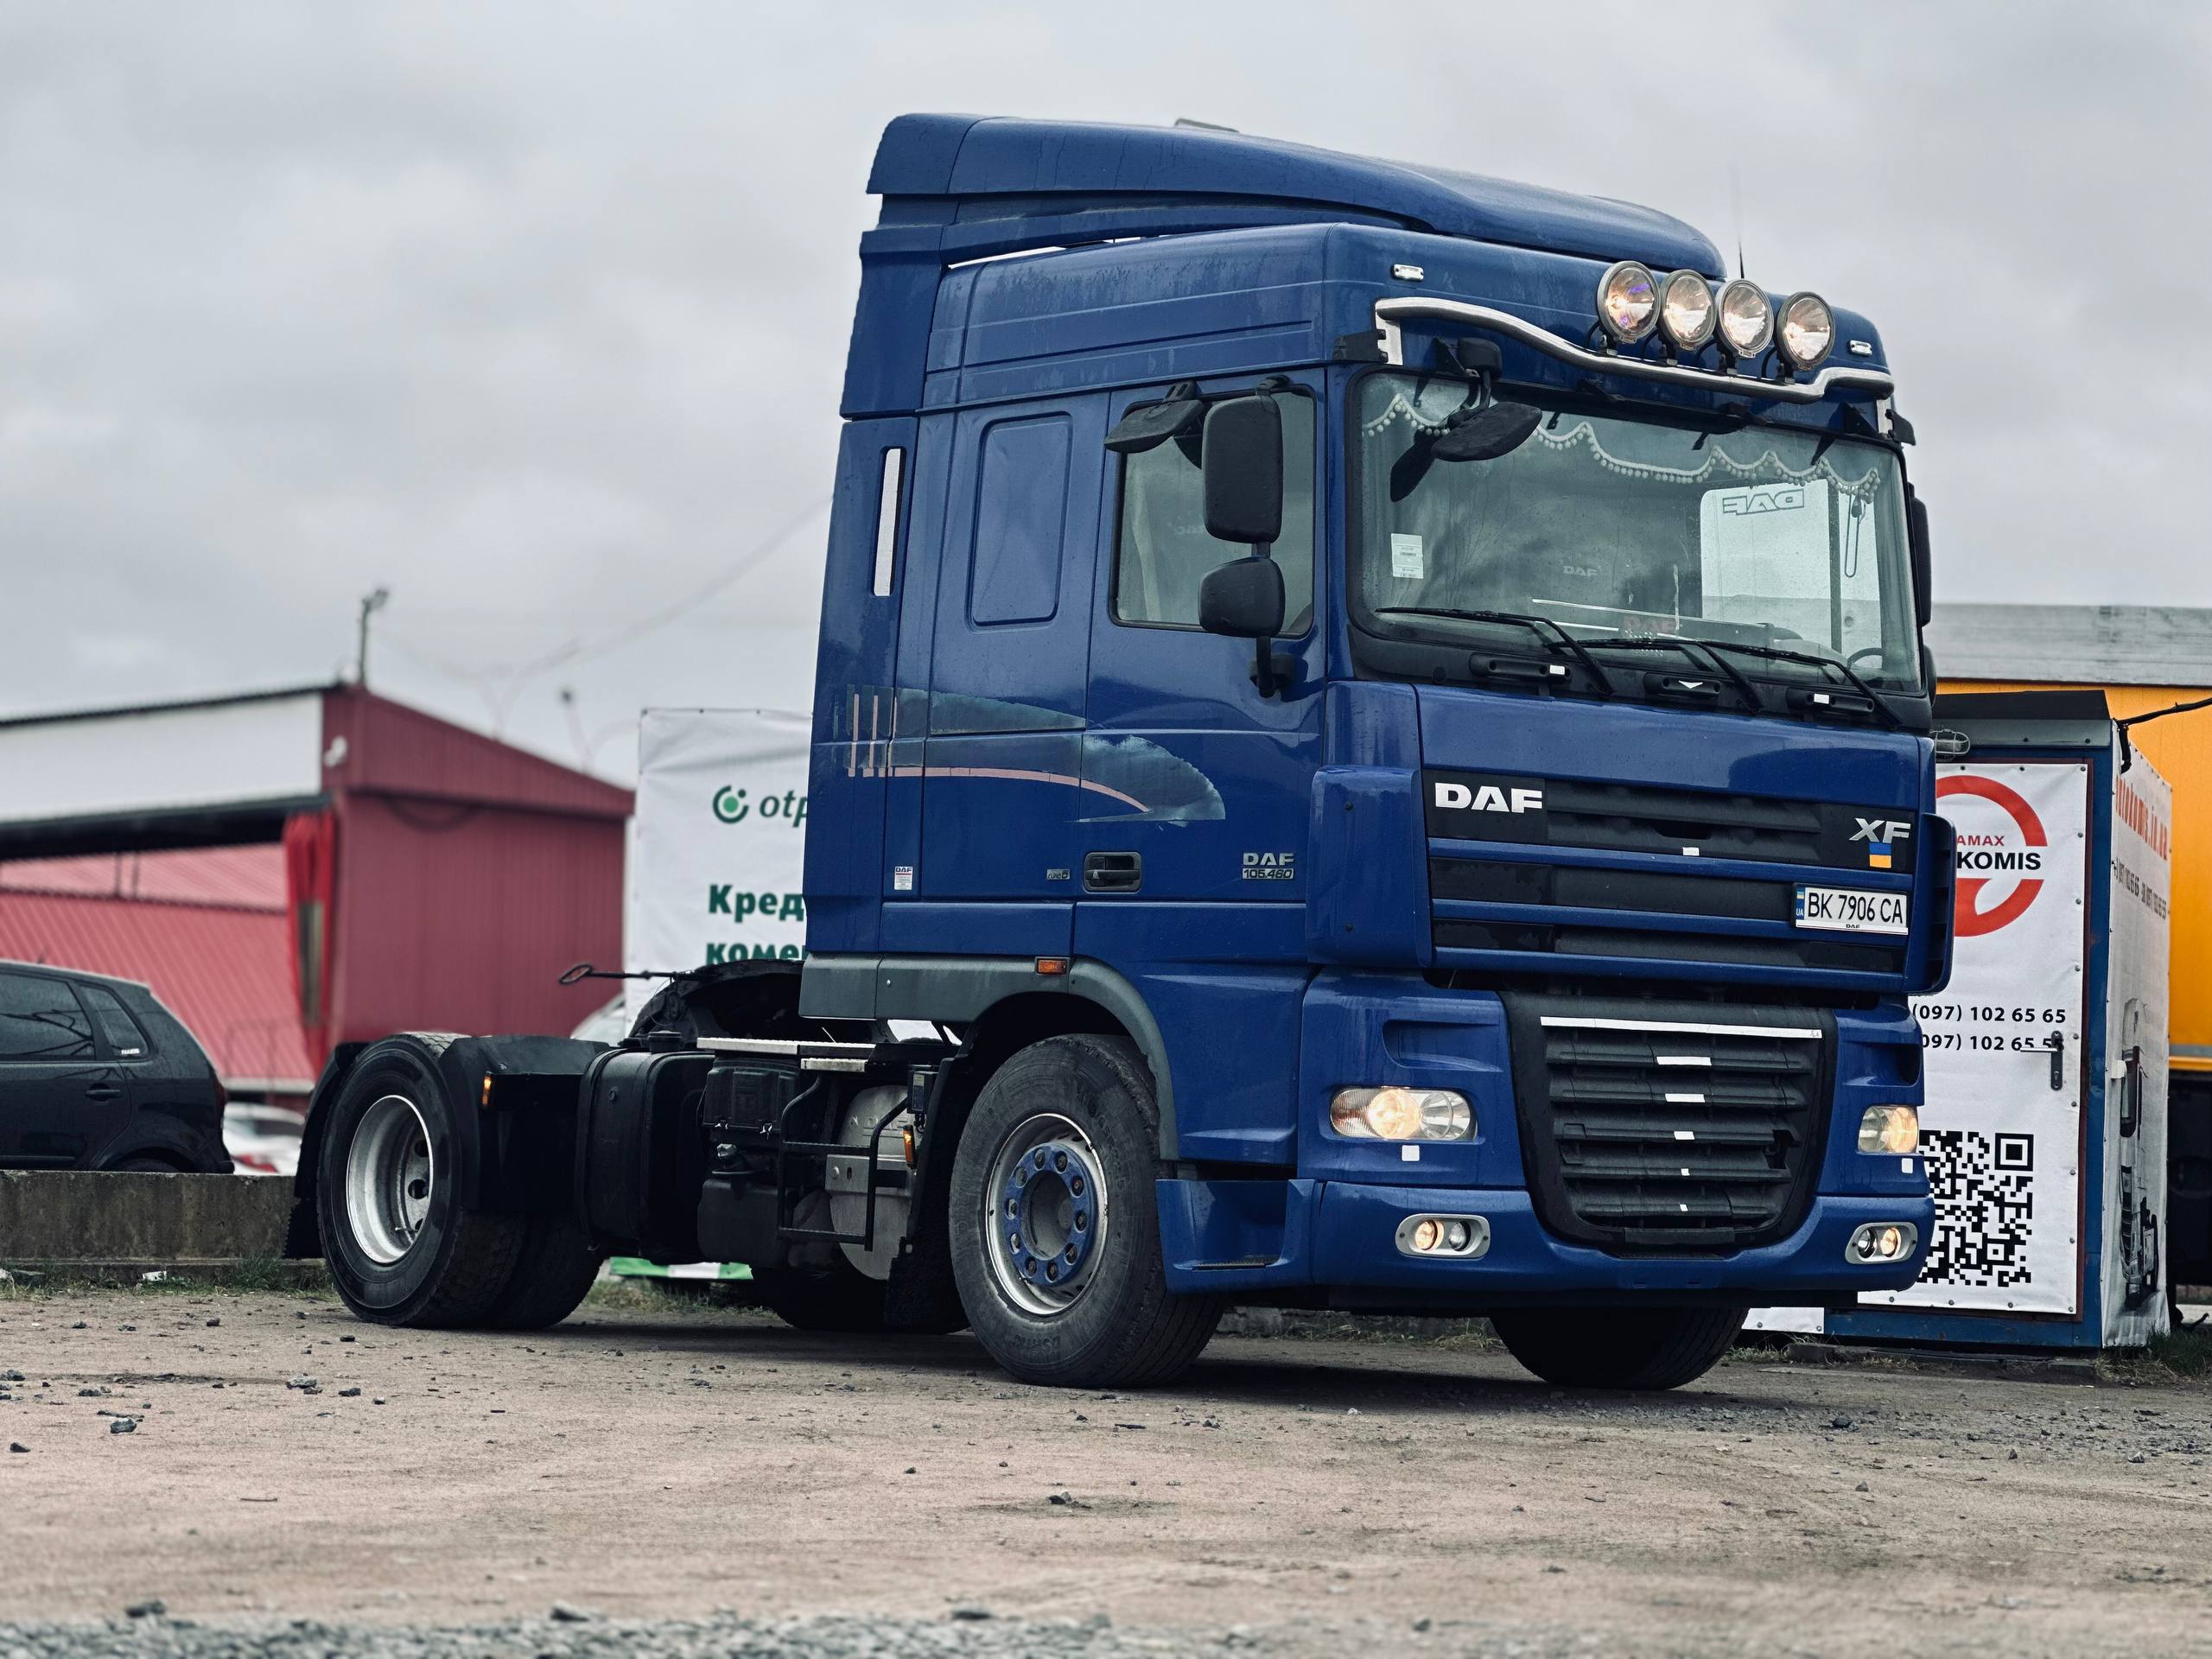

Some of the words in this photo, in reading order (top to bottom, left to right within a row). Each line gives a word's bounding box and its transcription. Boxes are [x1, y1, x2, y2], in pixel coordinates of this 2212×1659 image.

[1562, 565, 1598, 577] DAF
[1434, 782, 1543, 814] DAF
[1848, 817, 1911, 844] XF
[1956, 835, 2005, 847] AMAX
[1243, 852, 1294, 866] DAF
[1956, 851, 2042, 871] KOMIS
[1243, 868, 1294, 879] 105.460
[708, 883, 804, 924] Кред
[1796, 907, 1804, 917] UA
[1808, 892, 1834, 919] BK
[1838, 894, 1876, 922] 7906
[1880, 898, 1904, 924] CA
[706, 943, 808, 967] коме
[1912, 1003, 1962, 1022] (097)
[1970, 1006, 2005, 1022] 102
[2012, 1007, 2036, 1023] 65
[2042, 1008, 2066, 1024] 65
[1969, 1035, 2005, 1051] 102
[2011, 1037, 2035, 1052] 65
